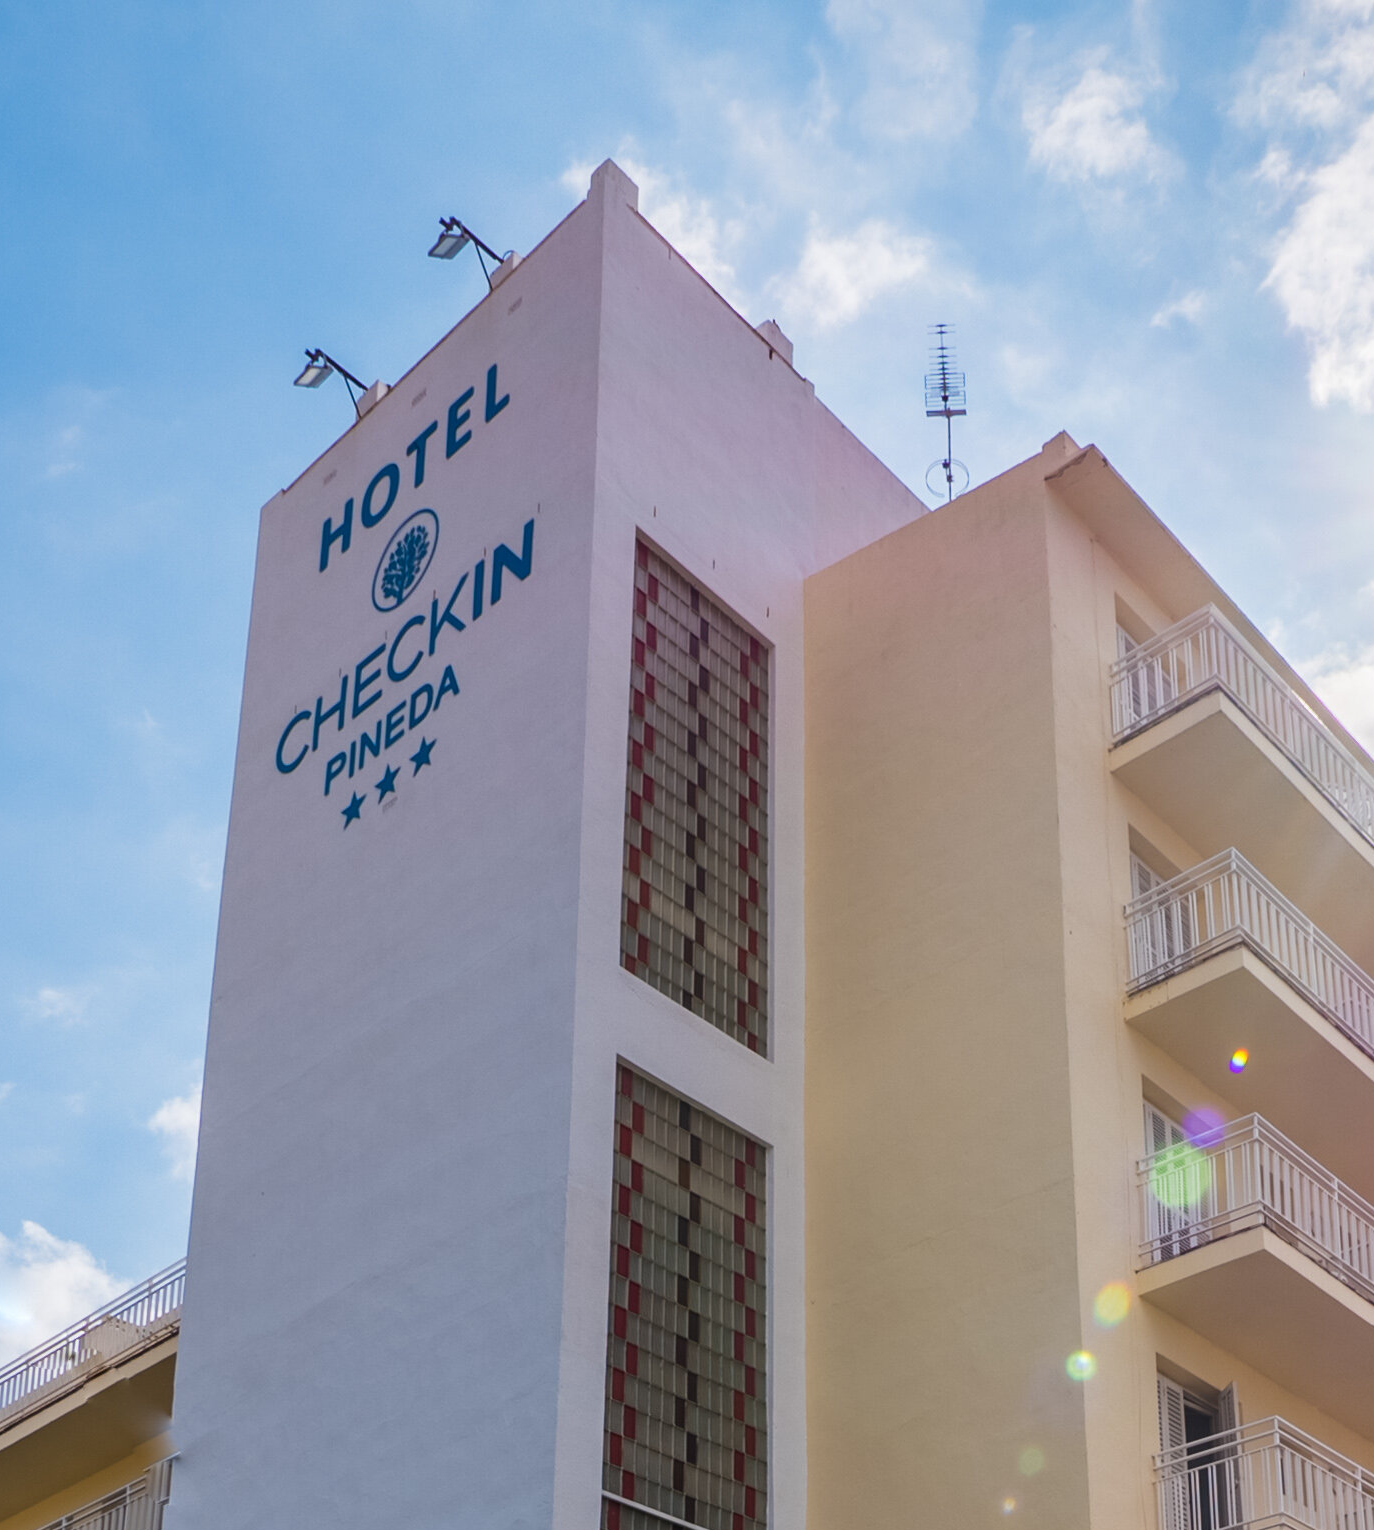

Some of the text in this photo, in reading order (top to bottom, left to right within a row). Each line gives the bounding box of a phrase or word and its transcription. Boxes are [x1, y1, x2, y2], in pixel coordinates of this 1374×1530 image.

[319, 364, 511, 573] HOTEL
[275, 518, 535, 774] CHECKIN
[324, 665, 461, 797] PINEDA
